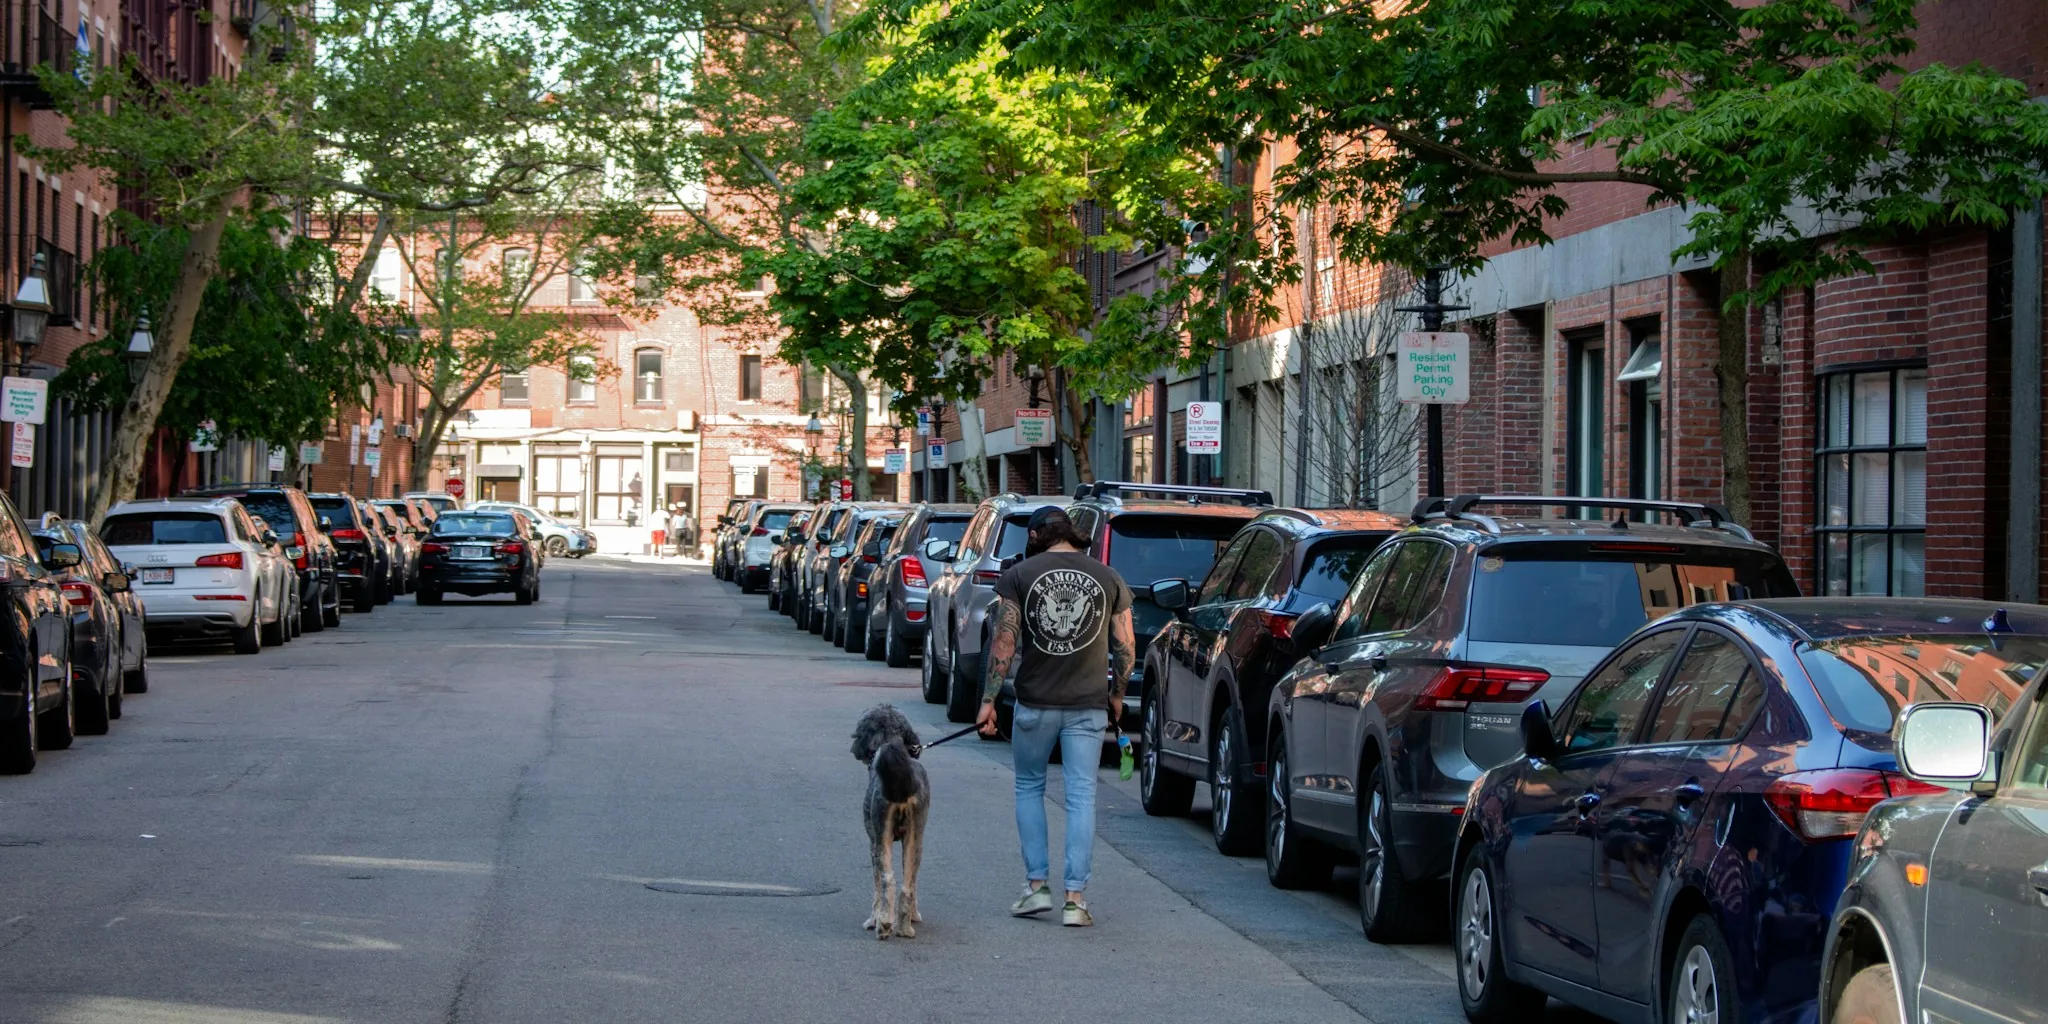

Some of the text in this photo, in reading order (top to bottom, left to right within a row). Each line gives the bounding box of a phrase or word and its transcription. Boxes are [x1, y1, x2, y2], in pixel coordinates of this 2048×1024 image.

[1409, 352, 1456, 362] Resident
[1416, 363, 1450, 373] Permit
[1413, 374, 1453, 386] Parking
[9, 389, 37, 397] Resident
[1421, 385, 1446, 397] Only
[10, 402, 34, 410] Parking
[14, 409, 29, 417] Only
[446, 484, 463, 493] STOP
[1033, 572, 1101, 597] RAMONES
[1470, 715, 1512, 724] TIGUAN
